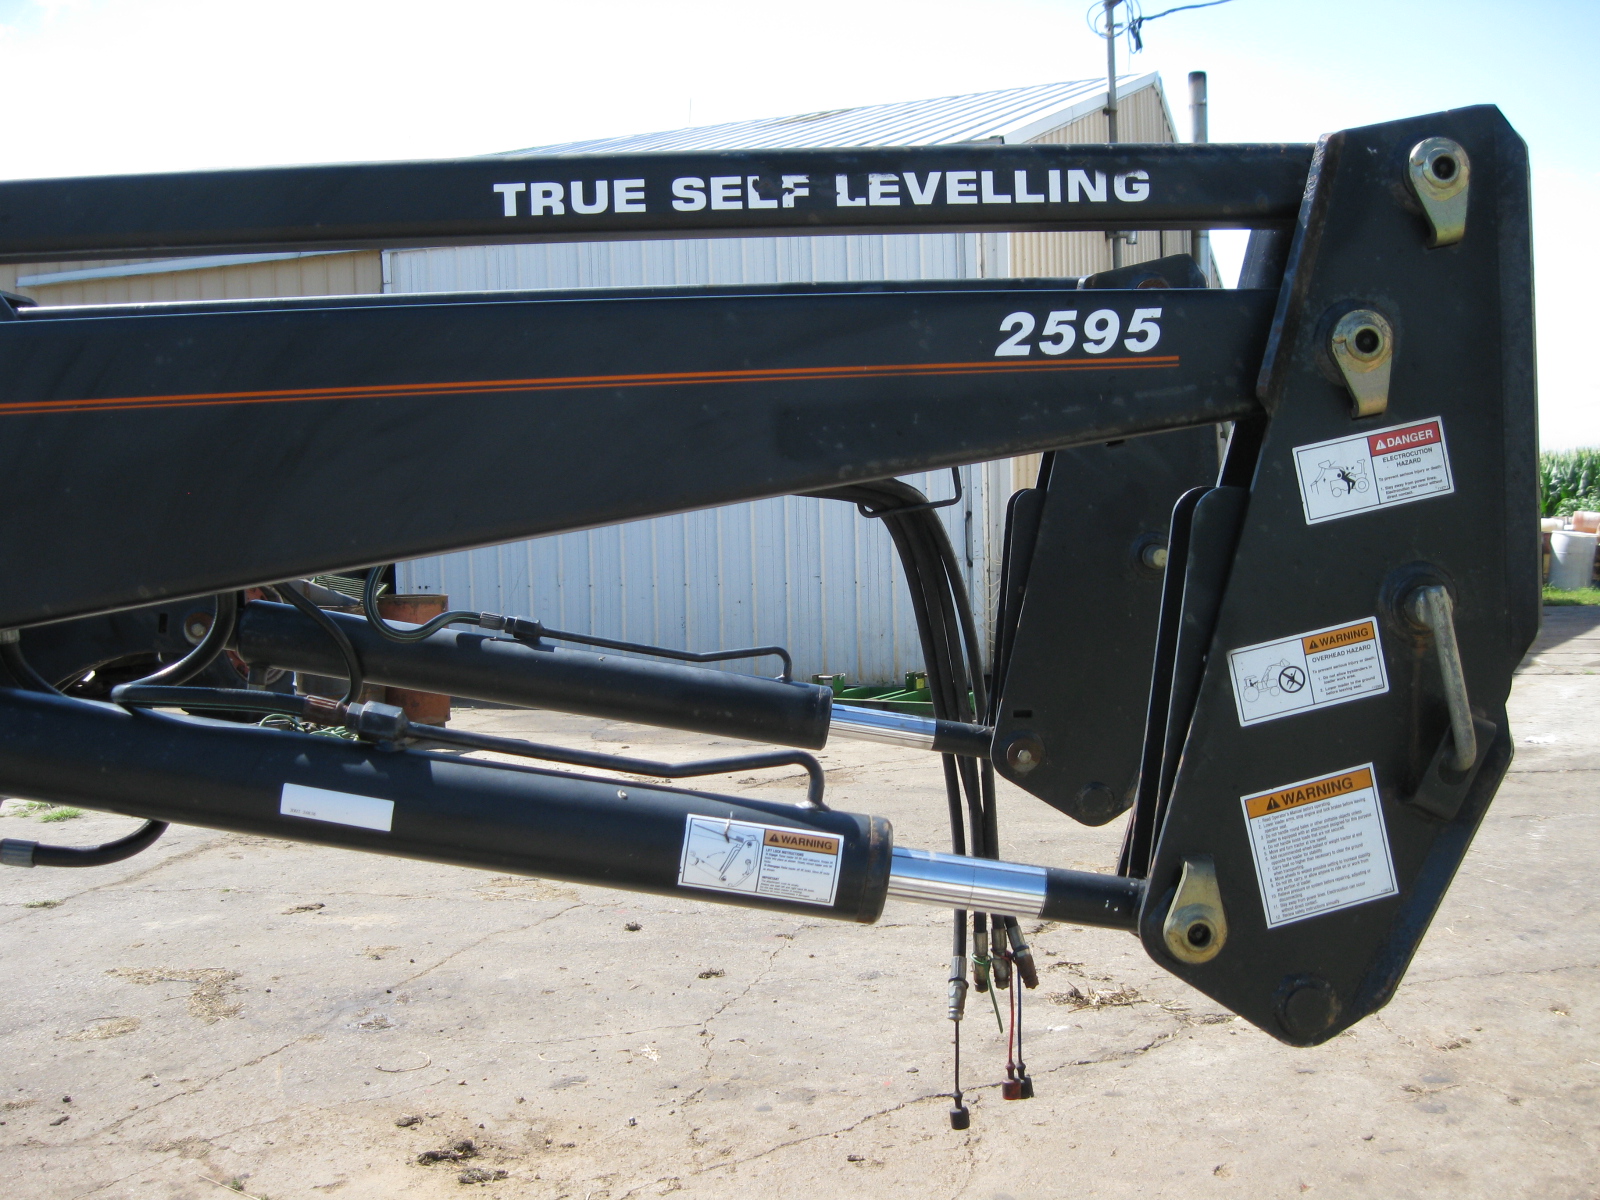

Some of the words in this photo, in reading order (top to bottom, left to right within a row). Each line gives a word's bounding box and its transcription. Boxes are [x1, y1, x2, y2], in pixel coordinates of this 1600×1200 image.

[494, 179, 646, 216] TRUE
[672, 176, 809, 211] SELF
[836, 170, 1149, 206] LEVELLING
[995, 308, 1162, 356] 2595
[1386, 428, 1433, 447] DANGER
[1382, 447, 1432, 462] ELECTROCUTION
[1396, 457, 1421, 467] HAZARD
[1319, 627, 1368, 646] WARNING
[1311, 650, 1345, 663] OVERHEAD
[1346, 643, 1371, 654] HAZARD
[1281, 778, 1353, 805] WARNING
[782, 833, 832, 850] WARNING
